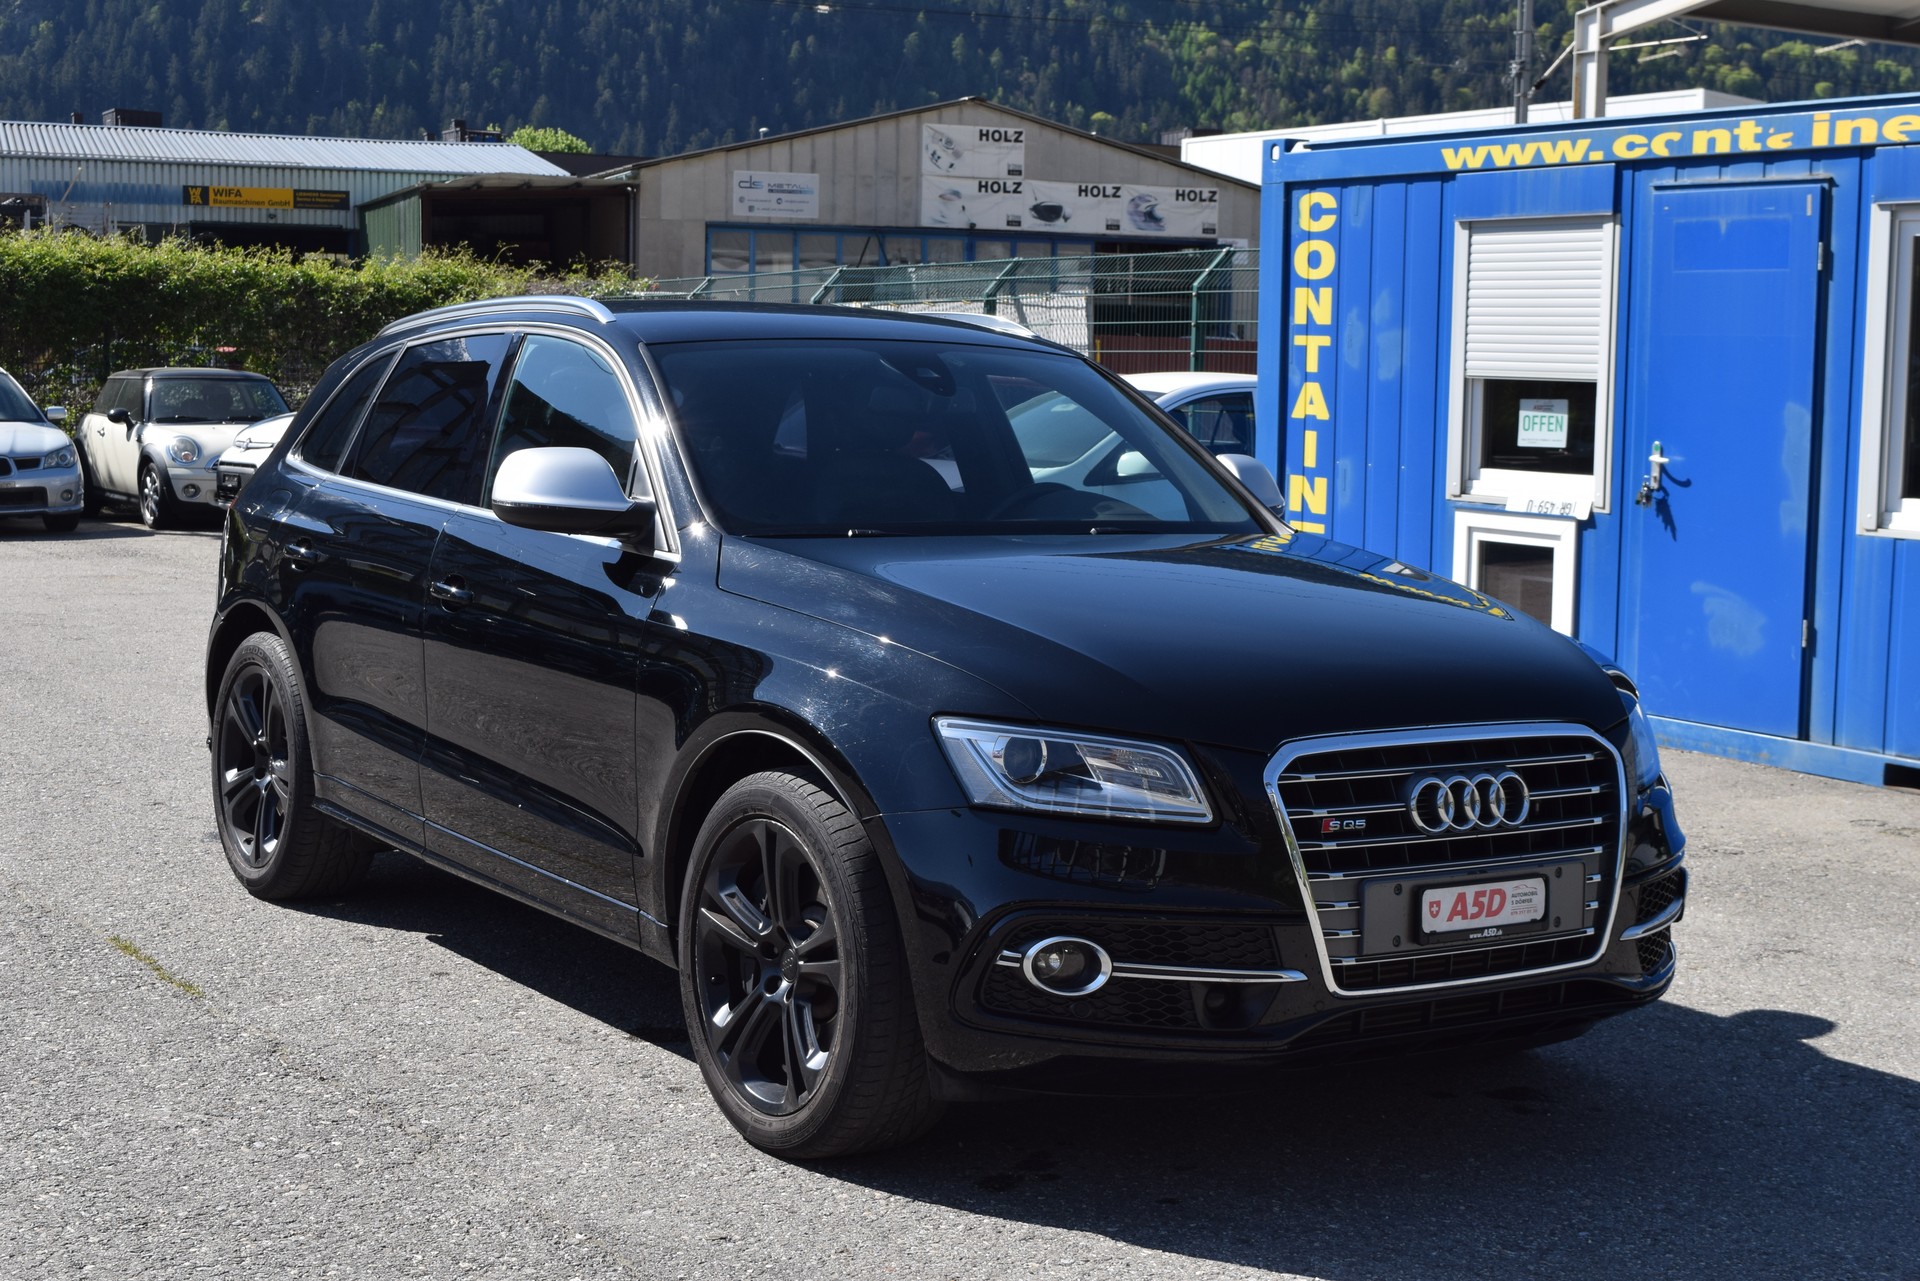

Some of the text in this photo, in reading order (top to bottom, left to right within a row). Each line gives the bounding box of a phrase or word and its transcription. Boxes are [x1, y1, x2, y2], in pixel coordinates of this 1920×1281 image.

[979, 129, 1023, 143] HOLZ
[213, 188, 242, 198] WIFA
[978, 180, 1022, 194] HOLZ
[1078, 185, 1121, 198] HOLZ
[213, 198, 265, 206] Baumaschinen
[1175, 189, 1217, 202] HOLZ
[1523, 415, 1564, 432] OFFEN
[1446, 888, 1507, 922] A5D
